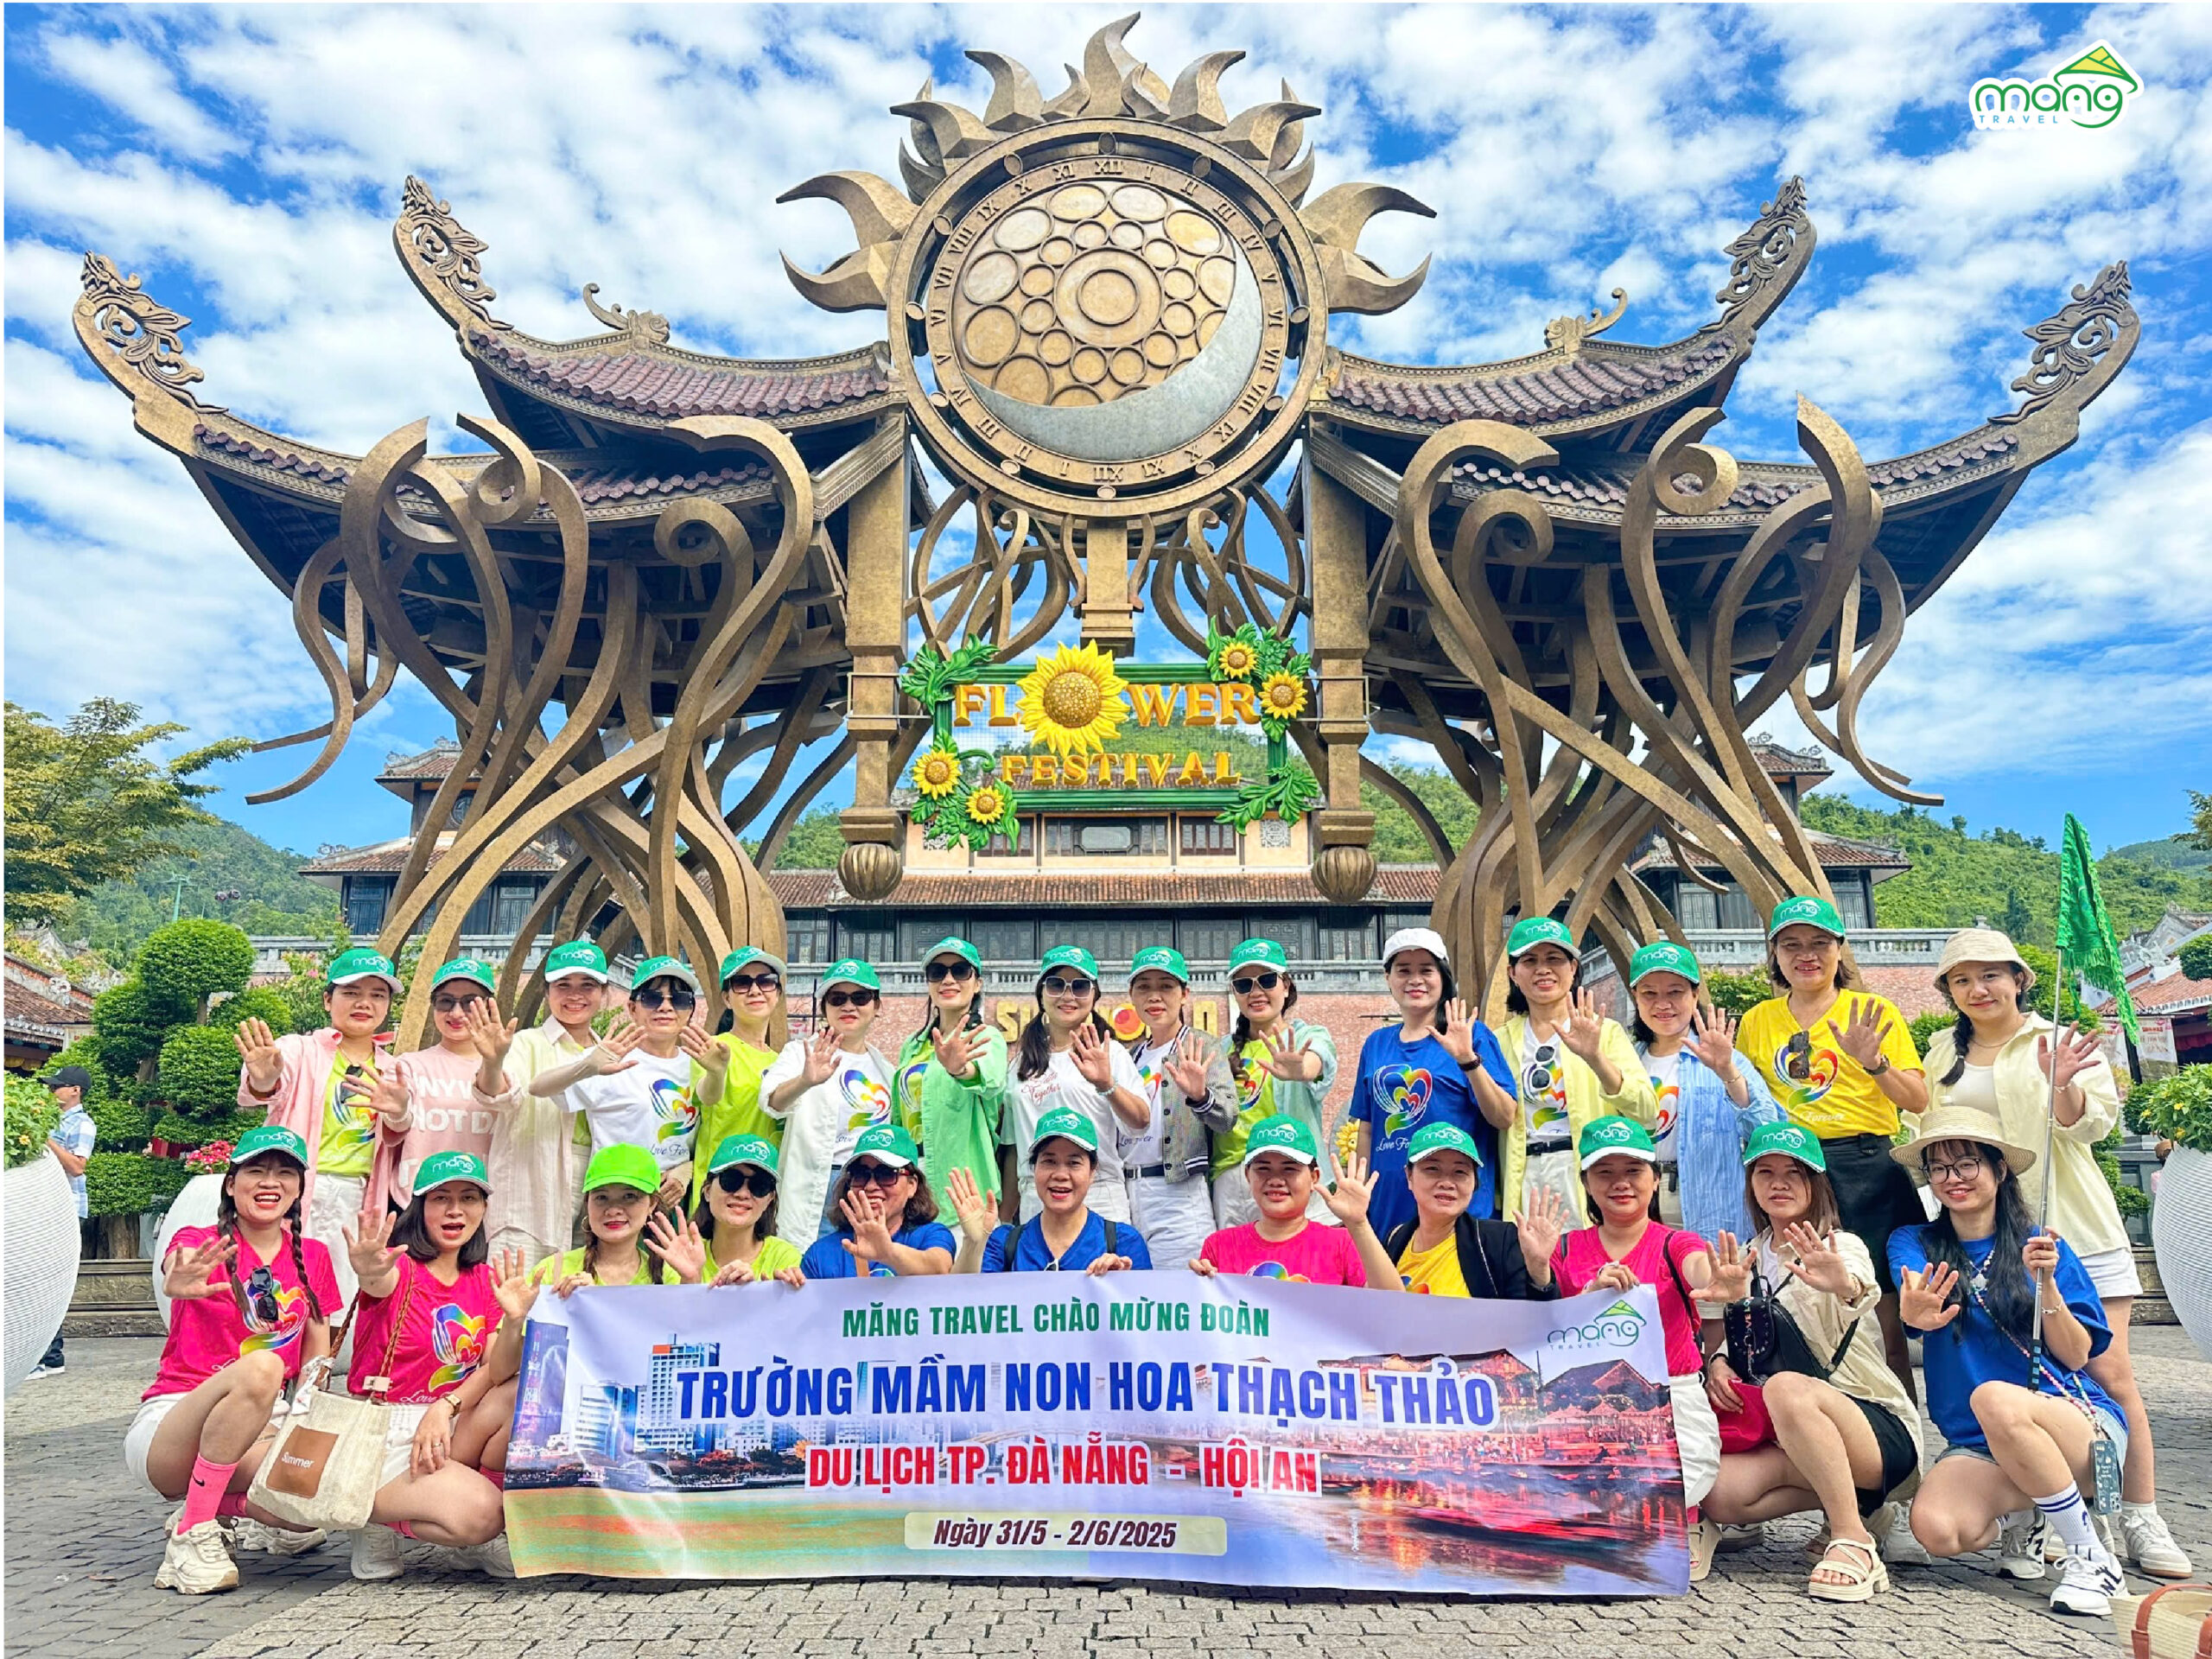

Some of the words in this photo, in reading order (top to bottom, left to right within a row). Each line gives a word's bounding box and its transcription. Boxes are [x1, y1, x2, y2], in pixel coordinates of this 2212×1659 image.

[1095, 161, 1123, 175] XII
[1001, 752, 1241, 786] FESTIVAL
[842, 1302, 919, 1337] MĂNG
[930, 1304, 1023, 1335] TRAVEL
[1033, 1296, 1100, 1332] CHÀO
[1109, 1296, 1190, 1332] MỪNG
[1200, 1300, 1269, 1337] ĐOÀN
[677, 1355, 852, 1420] TRƯỜNG
[872, 1353, 986, 1414] MẦM
[1006, 1362, 1090, 1411] NON
[1109, 1362, 1192, 1411] HOA
[1211, 1362, 1358, 1427] THẠCH
[1375, 1361, 1495, 1427] THẢO
[810, 1447, 852, 1487] DU
[865, 1446, 935, 1494] LỊCH
[946, 1446, 995, 1484] TP.
[1007, 1434, 1055, 1484] ĐÀ
[1063, 1431, 1148, 1485] NẴNG
[1204, 1438, 1260, 1497] HỘI
[1272, 1452, 1317, 1492] AN
[934, 1516, 992, 1547] Ngày
[996, 1520, 1046, 1545] 31/5
[1067, 1521, 1177, 1548] 2/6/2025
